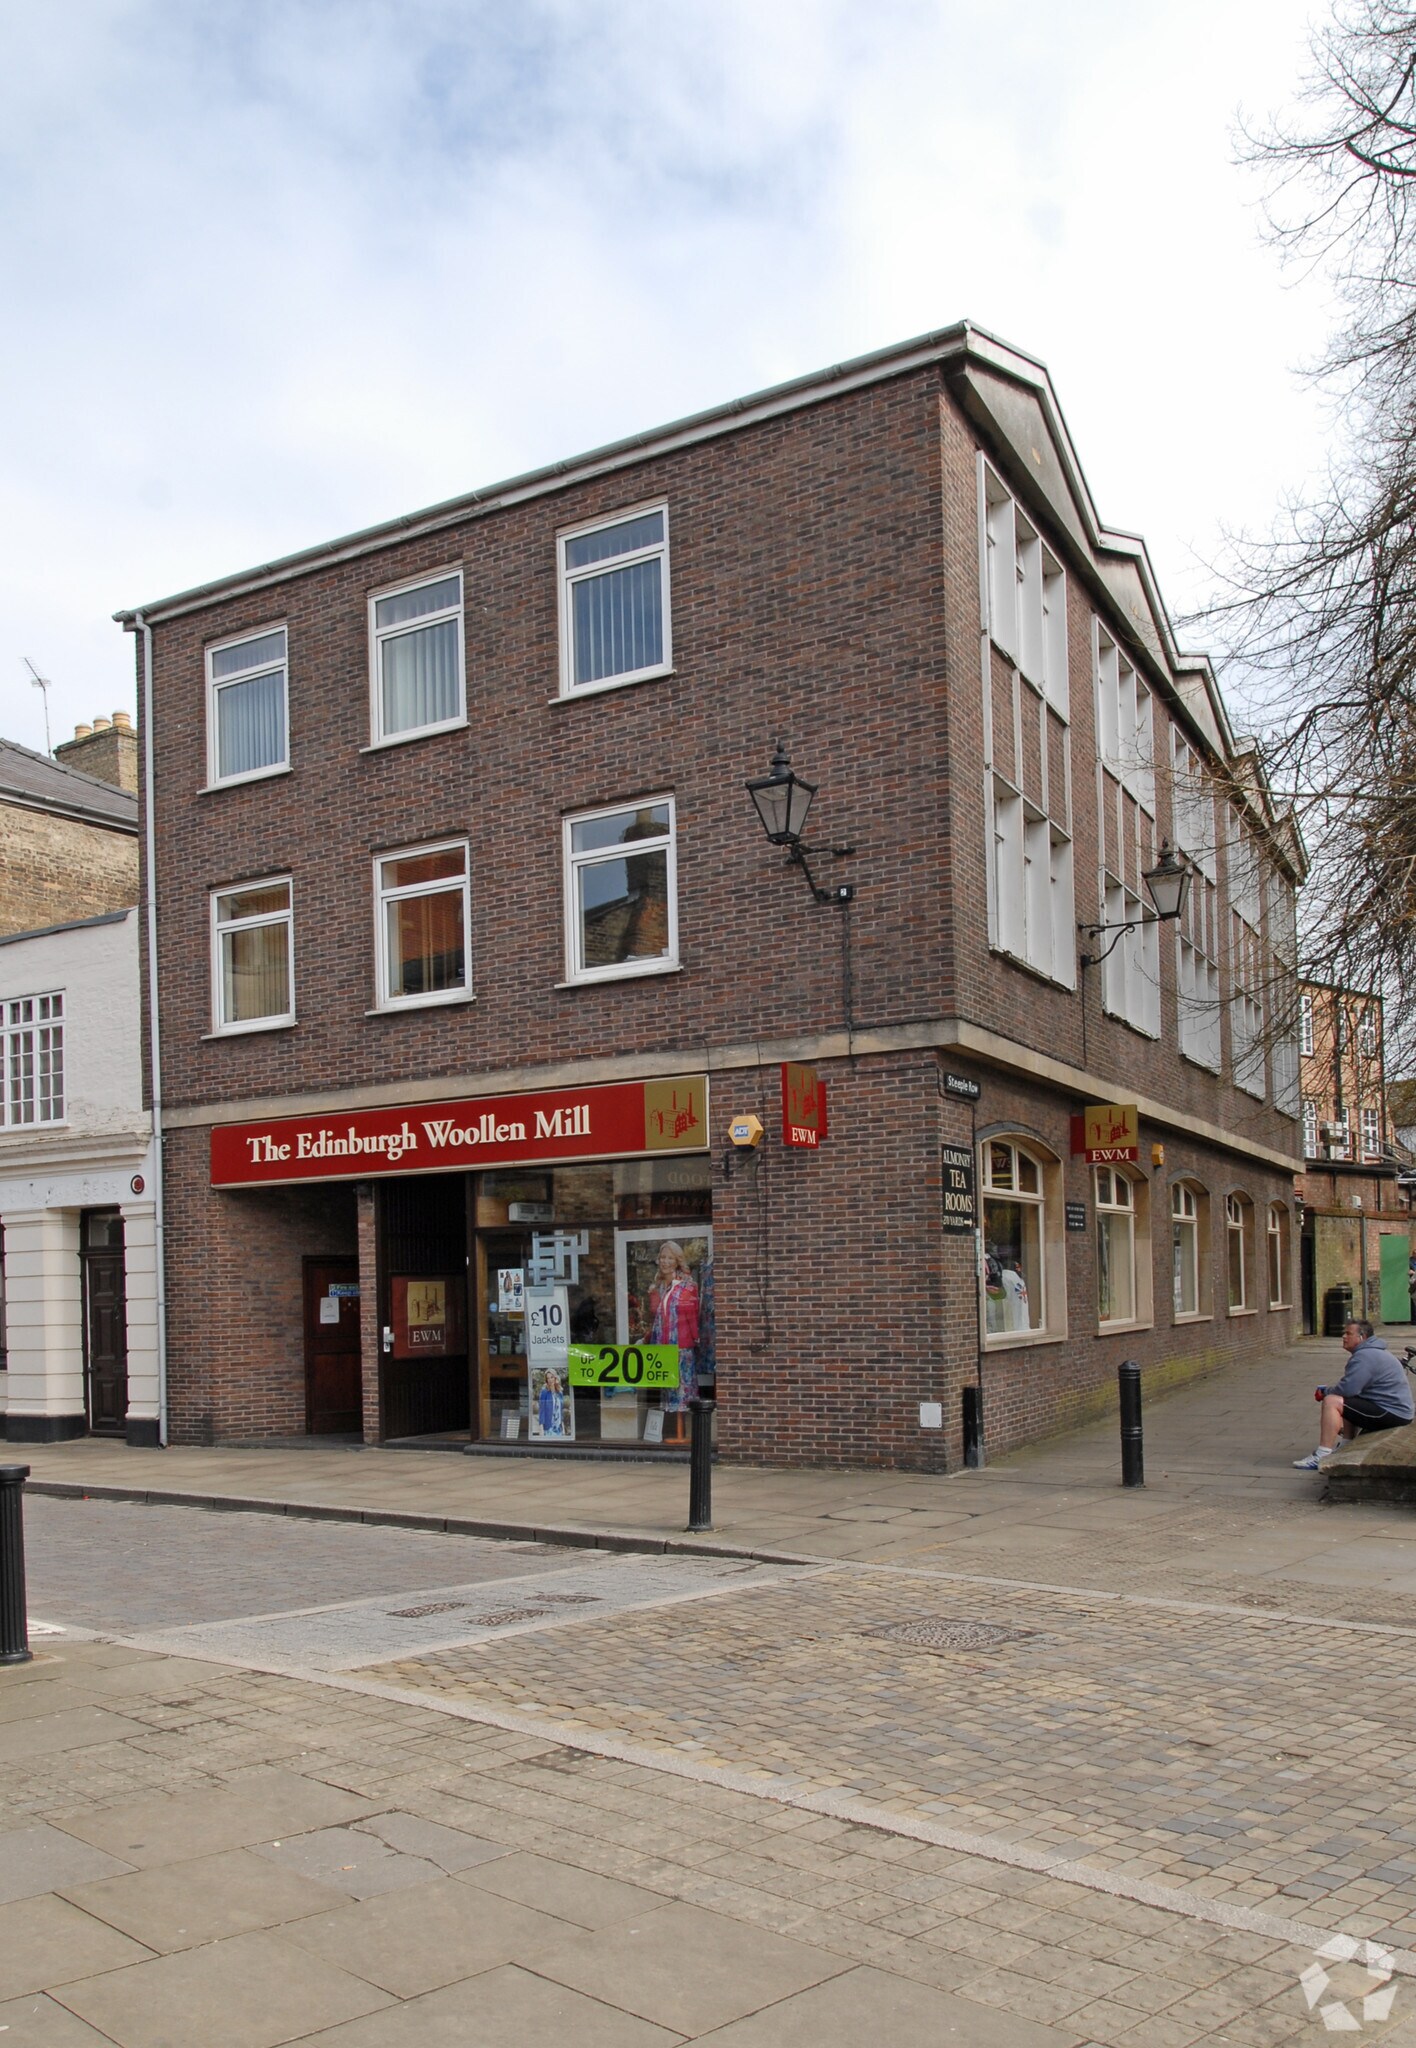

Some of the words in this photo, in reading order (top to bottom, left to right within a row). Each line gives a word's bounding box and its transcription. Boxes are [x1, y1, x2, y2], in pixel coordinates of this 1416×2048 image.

[948, 1075, 968, 1092] Steeple
[969, 1081, 978, 1093] Row
[246, 1135, 291, 1163] The
[296, 1122, 417, 1161] Edinburgh
[421, 1113, 527, 1148] Woollen
[534, 1104, 591, 1139] Mill
[735, 1127, 748, 1136] ADT
[792, 1127, 816, 1144] EWM
[943, 1149, 971, 1168] ALMONRY
[1092, 1148, 1130, 1161] EWM
[949, 1169, 966, 1189] TEA
[945, 1192, 973, 1213] ROOMS
[530, 1304, 562, 1327] £10
[413, 1329, 441, 1343] EWM
[532, 1336, 565, 1345] Jackets
[580, 1355, 595, 1365] UP
[580, 1368, 594, 1378] TO
[646, 1371, 669, 1381] OFF
